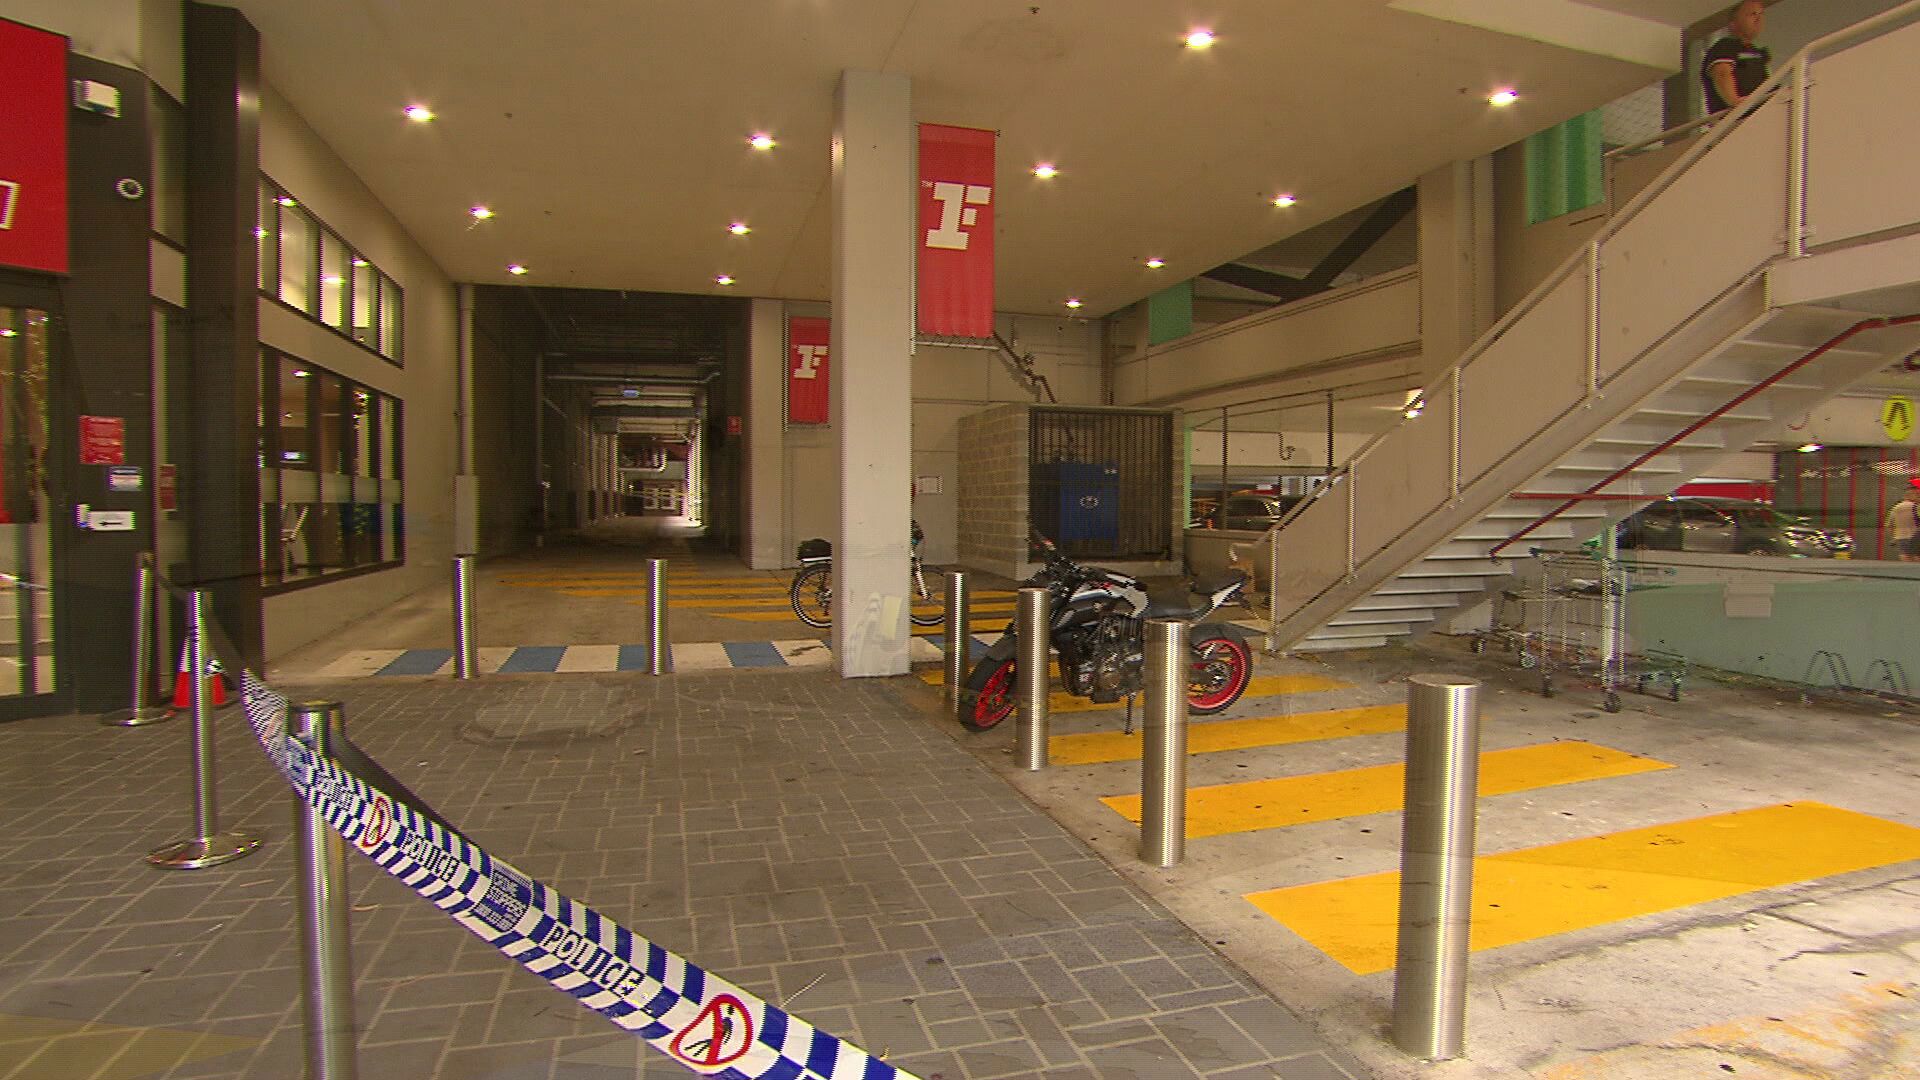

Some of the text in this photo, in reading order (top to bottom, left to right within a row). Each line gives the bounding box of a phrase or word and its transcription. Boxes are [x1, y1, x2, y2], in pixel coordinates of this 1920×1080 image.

[315, 770, 356, 813] POLICE
[400, 828, 462, 883] POLICE
[487, 886, 528, 919] STOPPERS
[493, 871, 520, 898] CRIME
[541, 920, 646, 997] POLICE
